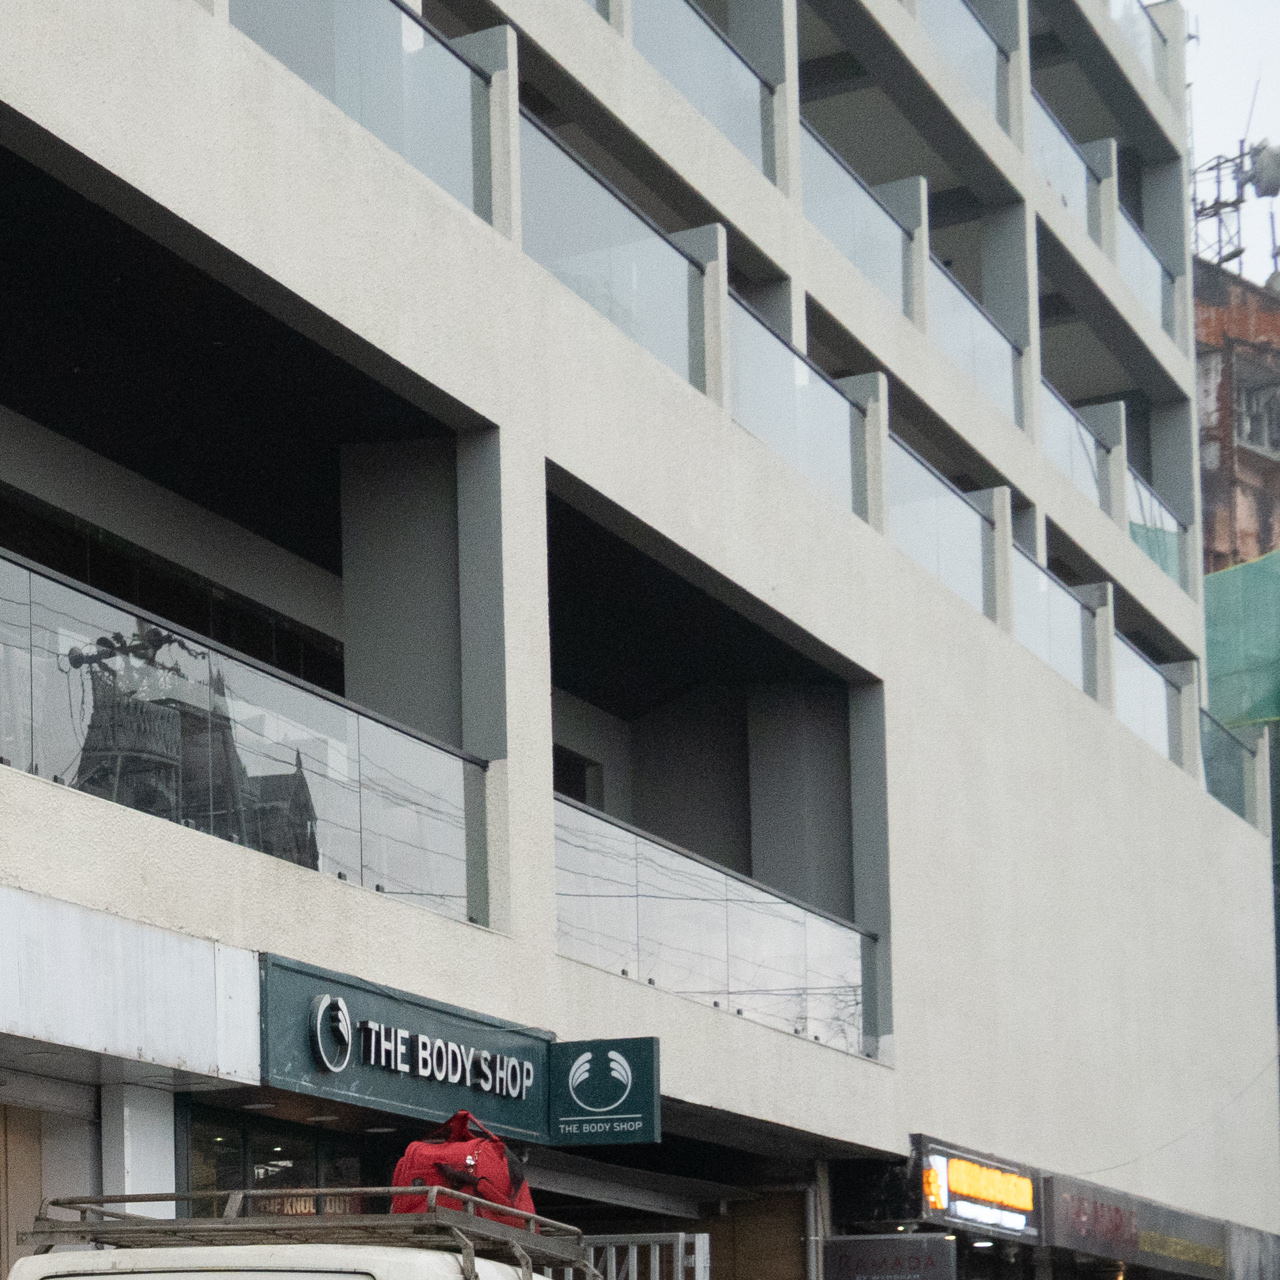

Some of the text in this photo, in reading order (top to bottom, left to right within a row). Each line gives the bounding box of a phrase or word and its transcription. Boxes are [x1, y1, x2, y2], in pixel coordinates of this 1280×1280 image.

[366, 1020, 534, 1100] THE BODY SHOP
[559, 1120, 643, 1134] THE BODY SHOP
